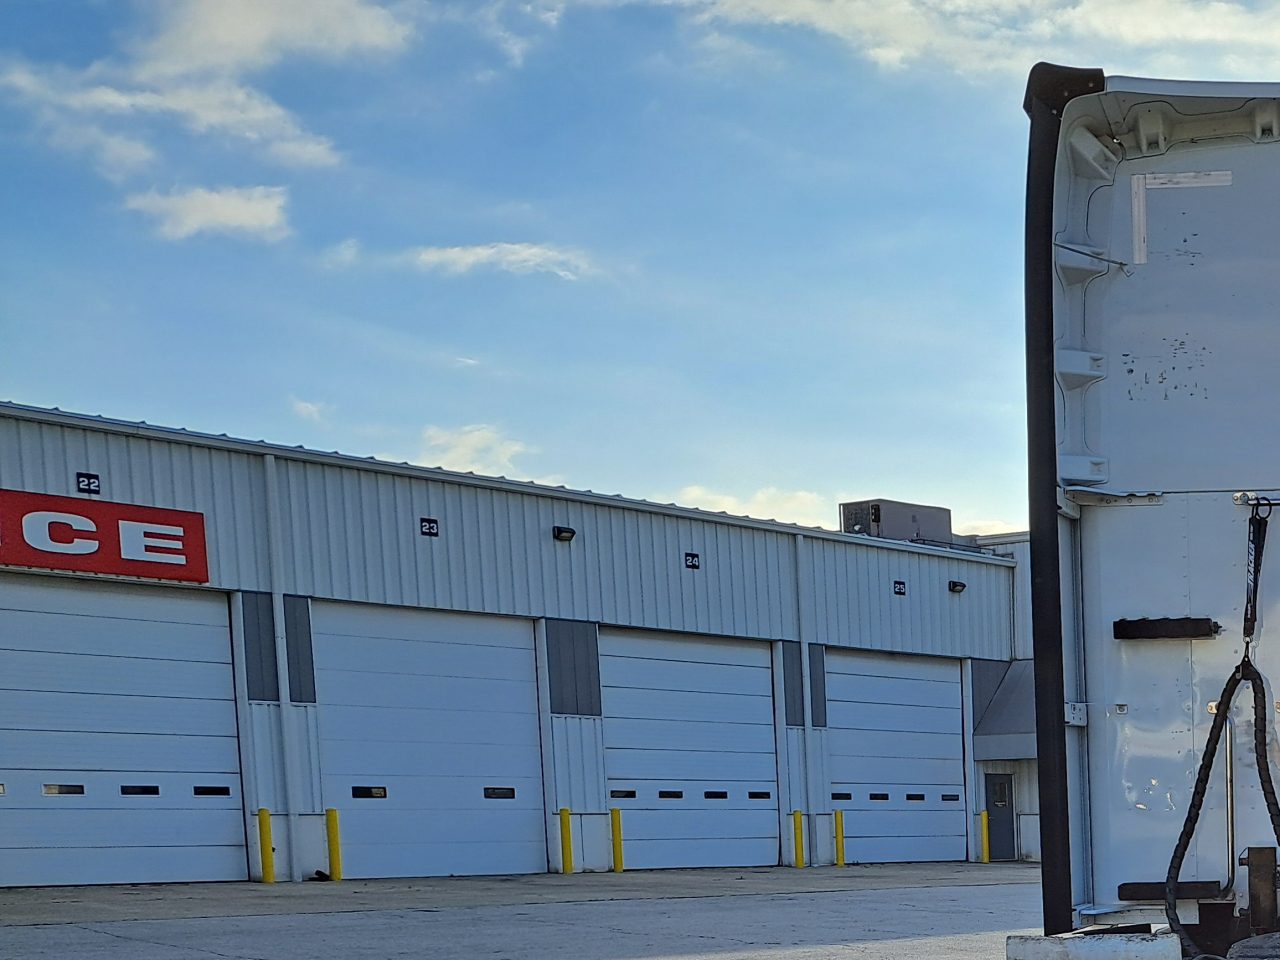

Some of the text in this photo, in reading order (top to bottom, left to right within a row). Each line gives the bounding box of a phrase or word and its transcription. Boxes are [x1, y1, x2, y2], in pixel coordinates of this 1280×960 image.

[79, 477, 99, 490] 22
[422, 522, 437, 533] 23
[686, 556, 699, 566] 24
[1247, 541, 1256, 585] TRACKER
[895, 584, 905, 593] 25
